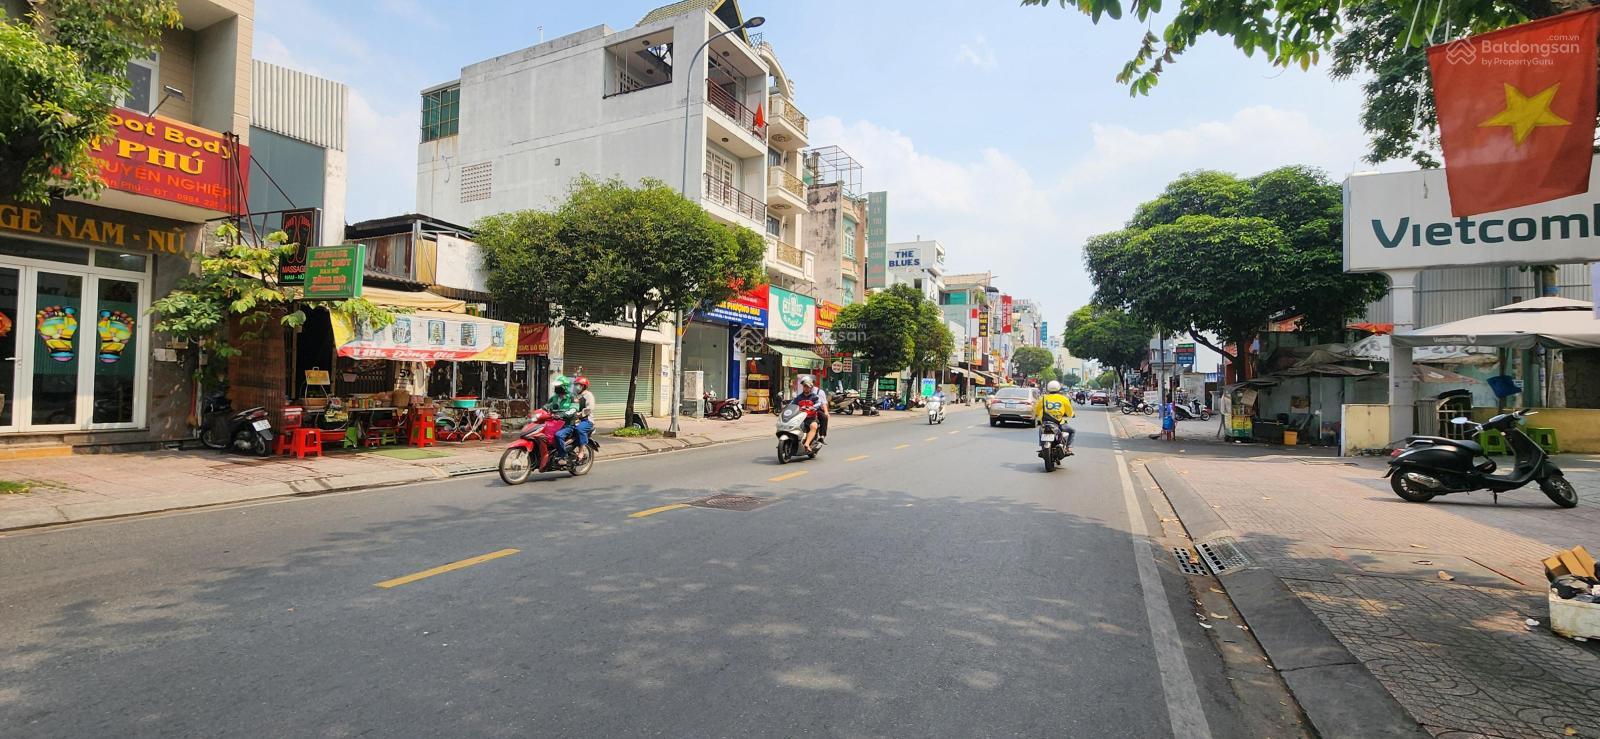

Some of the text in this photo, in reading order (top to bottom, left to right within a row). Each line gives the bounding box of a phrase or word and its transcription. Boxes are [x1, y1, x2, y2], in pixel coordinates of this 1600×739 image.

[106, 113, 232, 160] oot Body
[116, 138, 206, 175] PHÚ
[55, 213, 126, 246] NAM
[1371, 204, 1600, 248] Vietcom
[888, 258, 920, 267] BLUES
[895, 250, 914, 258] THE
[1045, 400, 1062, 410] be
